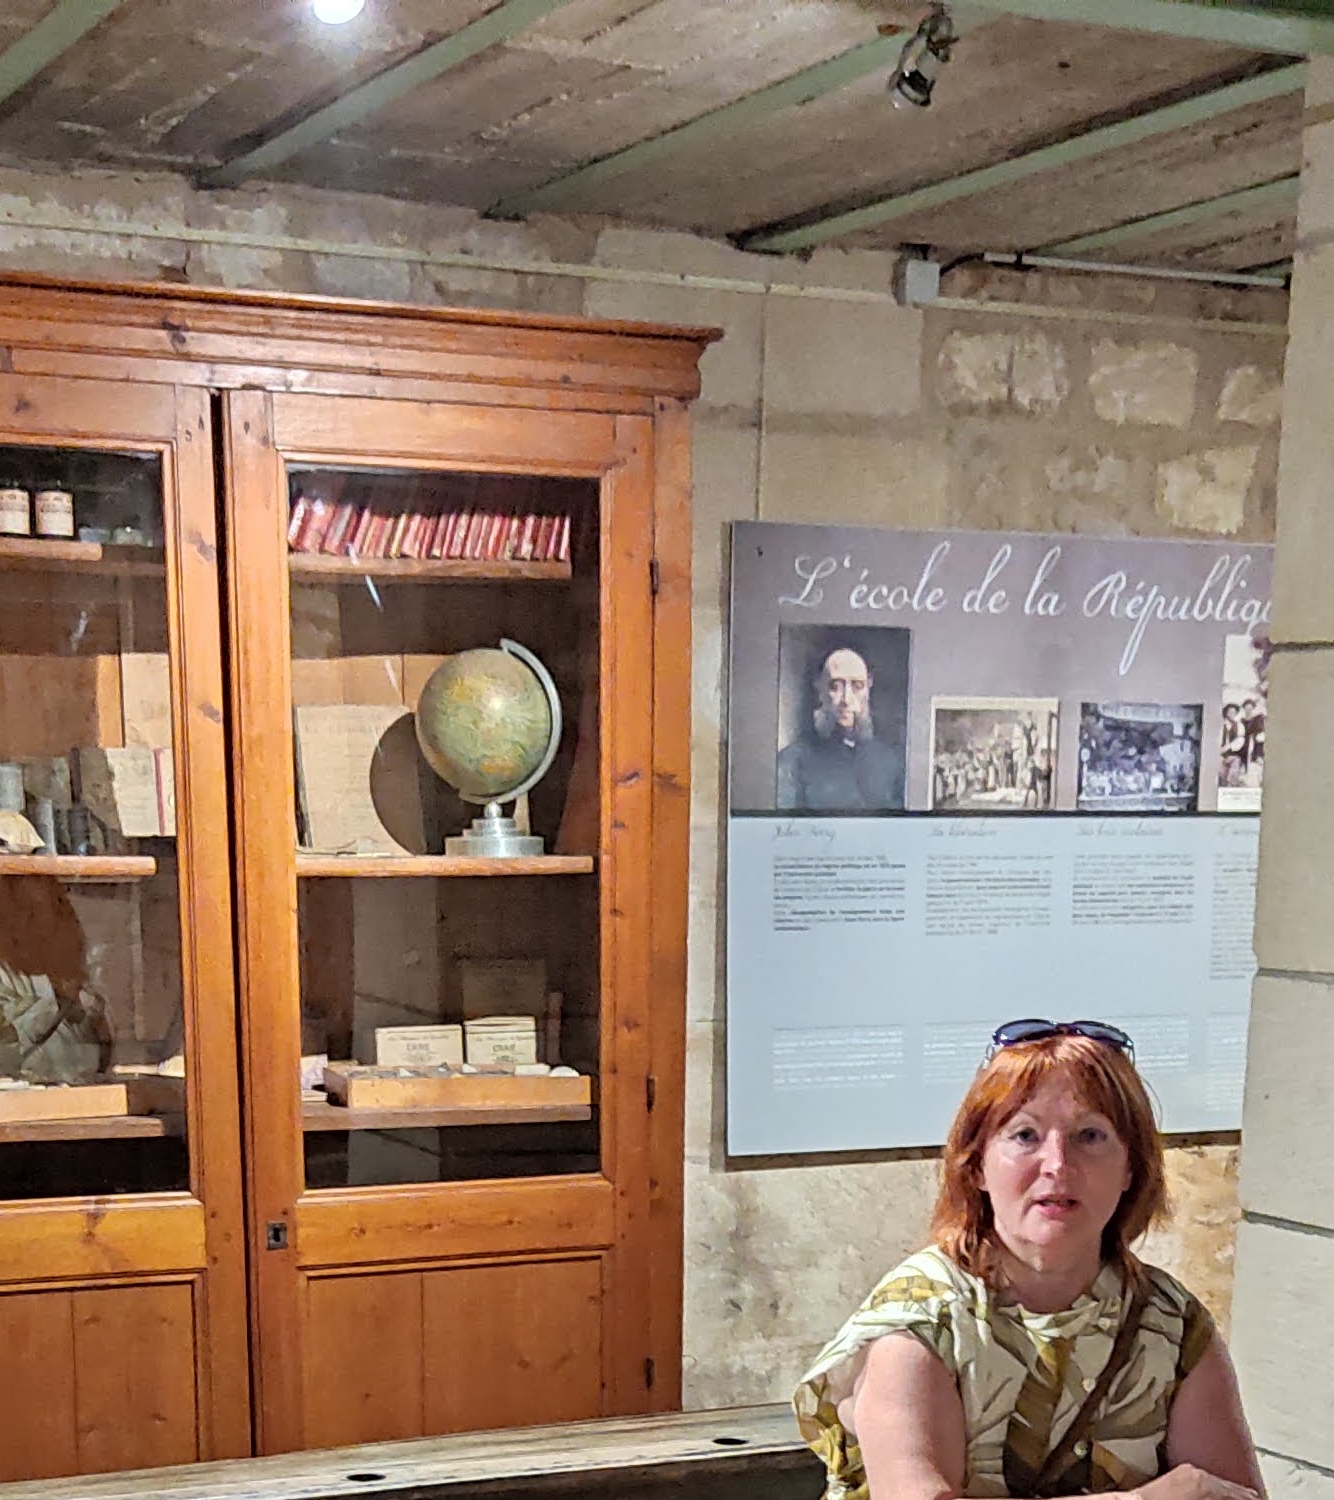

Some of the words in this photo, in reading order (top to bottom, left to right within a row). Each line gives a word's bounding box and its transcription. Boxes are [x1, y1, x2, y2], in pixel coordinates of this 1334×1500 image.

[779, 540, 951, 611] L'école
[963, 544, 1012, 614] de
[1024, 545, 1067, 616] la
[1082, 554, 1273, 676] Républiq
